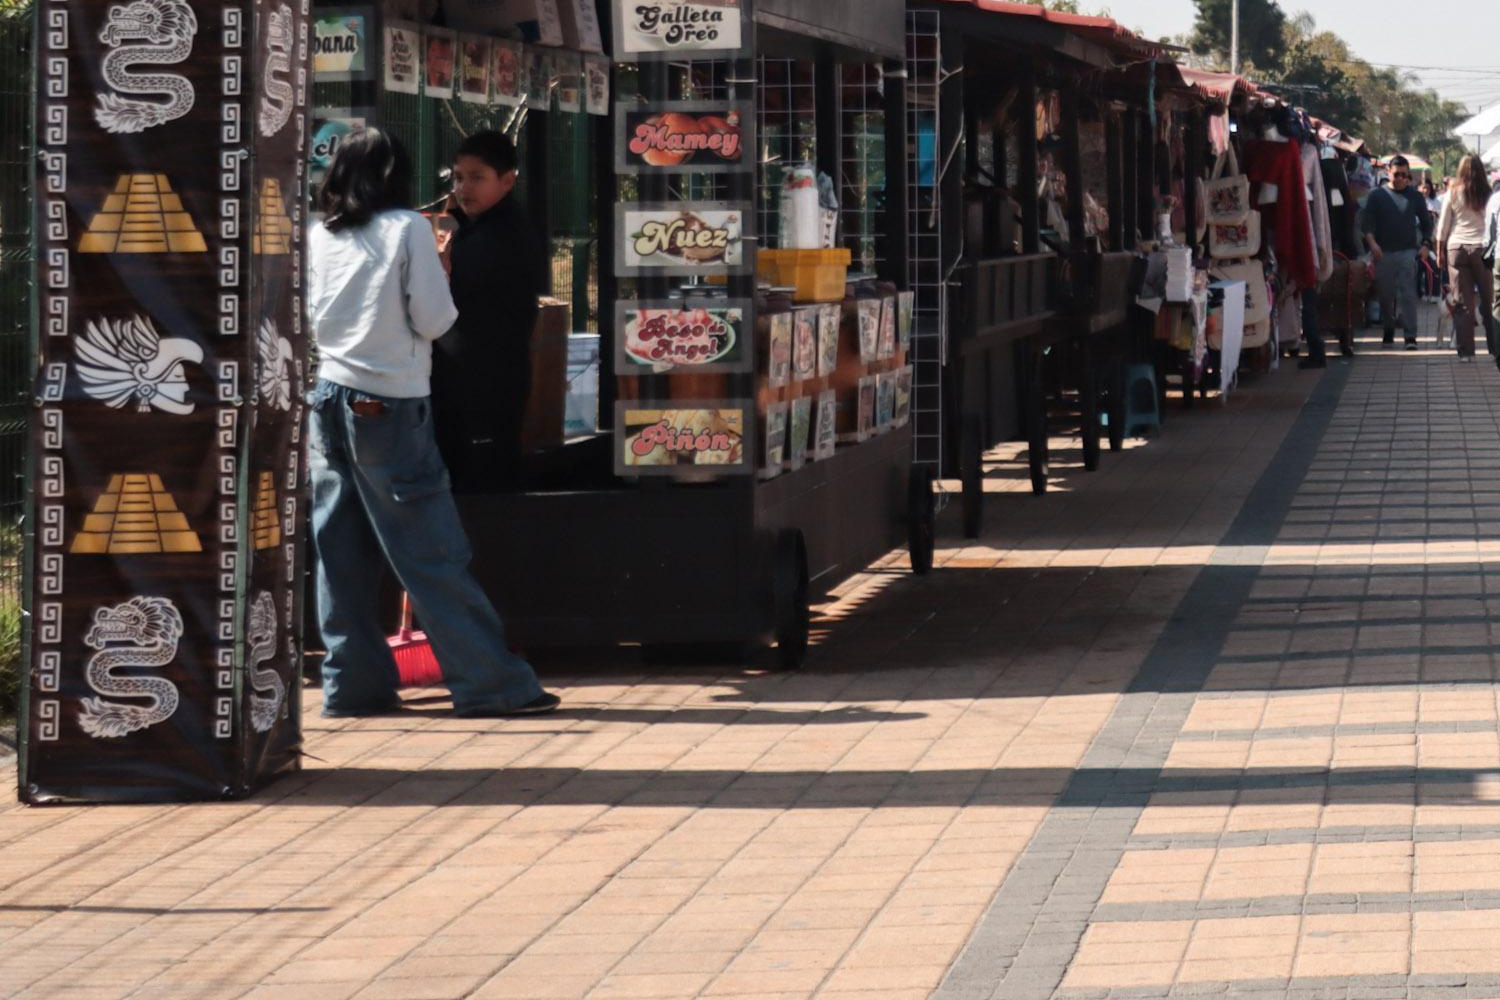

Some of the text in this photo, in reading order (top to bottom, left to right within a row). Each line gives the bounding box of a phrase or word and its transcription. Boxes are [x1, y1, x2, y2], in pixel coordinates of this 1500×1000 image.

[635, 5, 723, 30] Galleta
[313, 34, 356, 54] bana
[665, 24, 719, 44] Oreo
[629, 124, 739, 156] Mamey
[634, 218, 729, 256] Nuez
[638, 315, 725, 342] Beso de
[631, 419, 730, 456] Piñón
